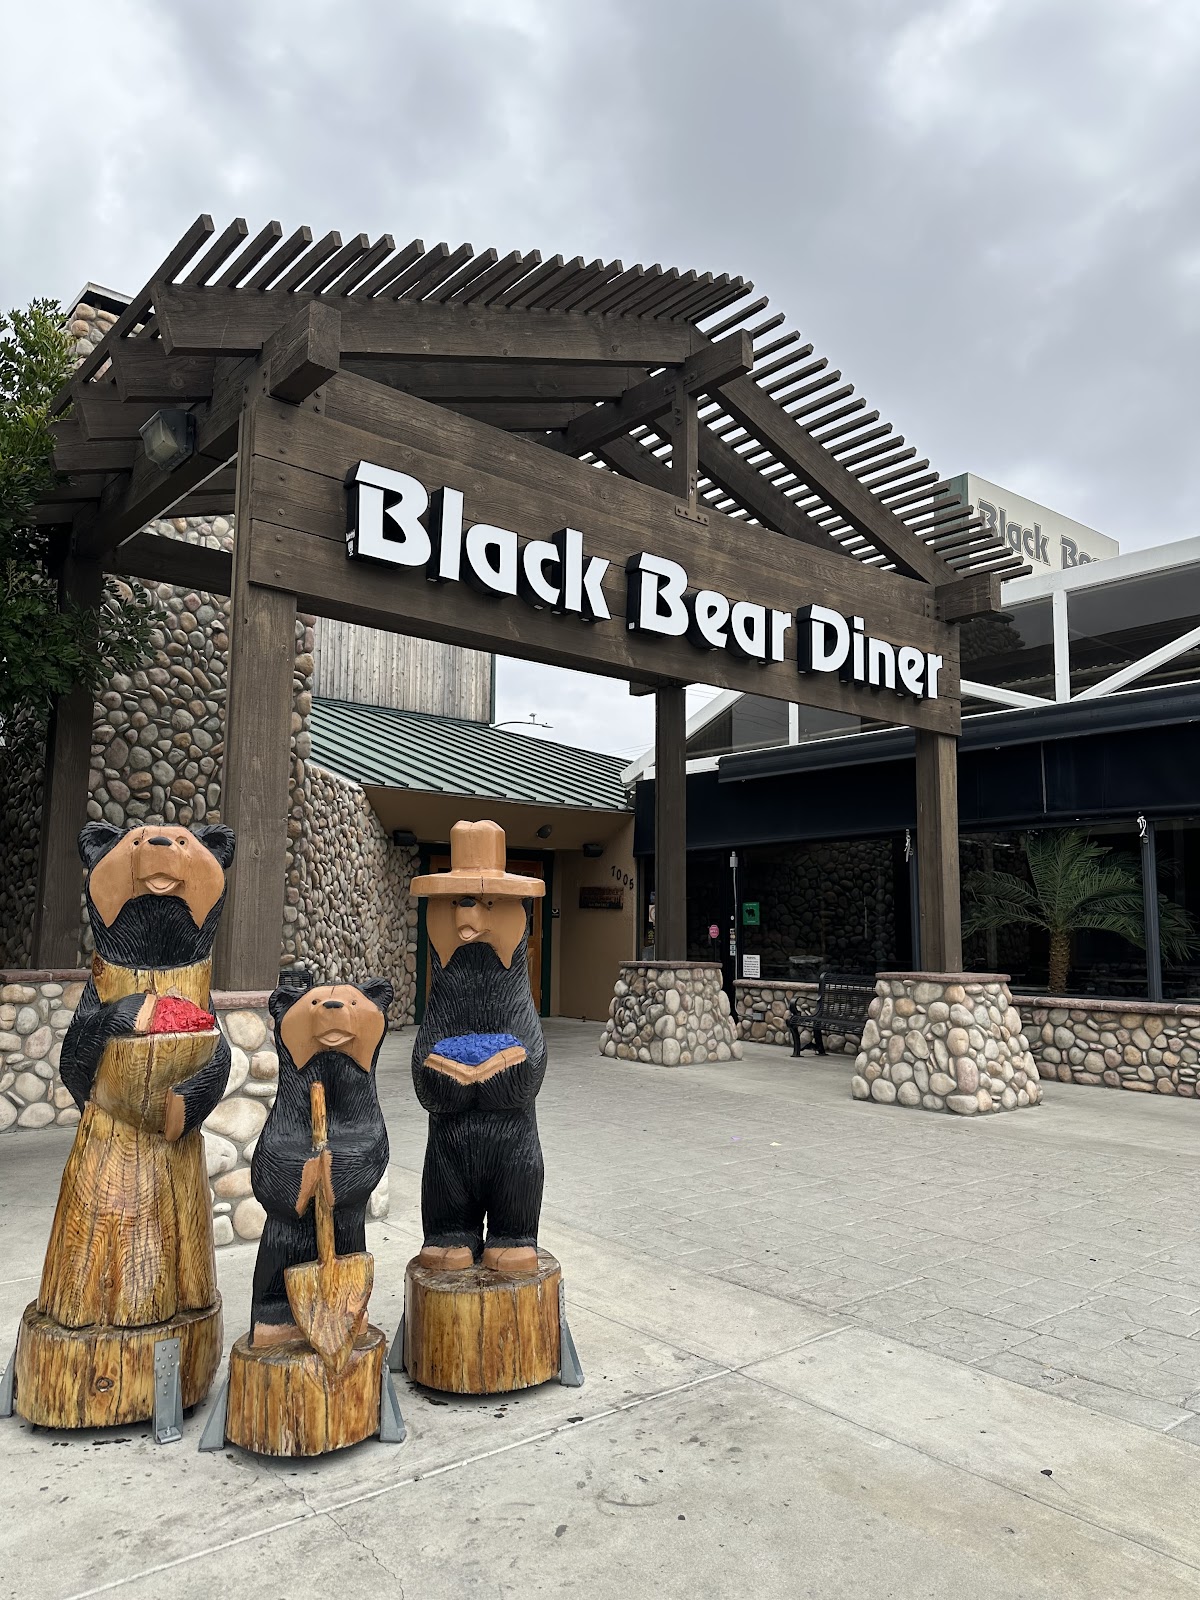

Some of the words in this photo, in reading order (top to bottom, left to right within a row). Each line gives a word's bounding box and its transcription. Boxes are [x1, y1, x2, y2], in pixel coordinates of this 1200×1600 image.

[352, 460, 611, 619] Black
[637, 552, 792, 662] Bear
[808, 604, 943, 699] Diner
